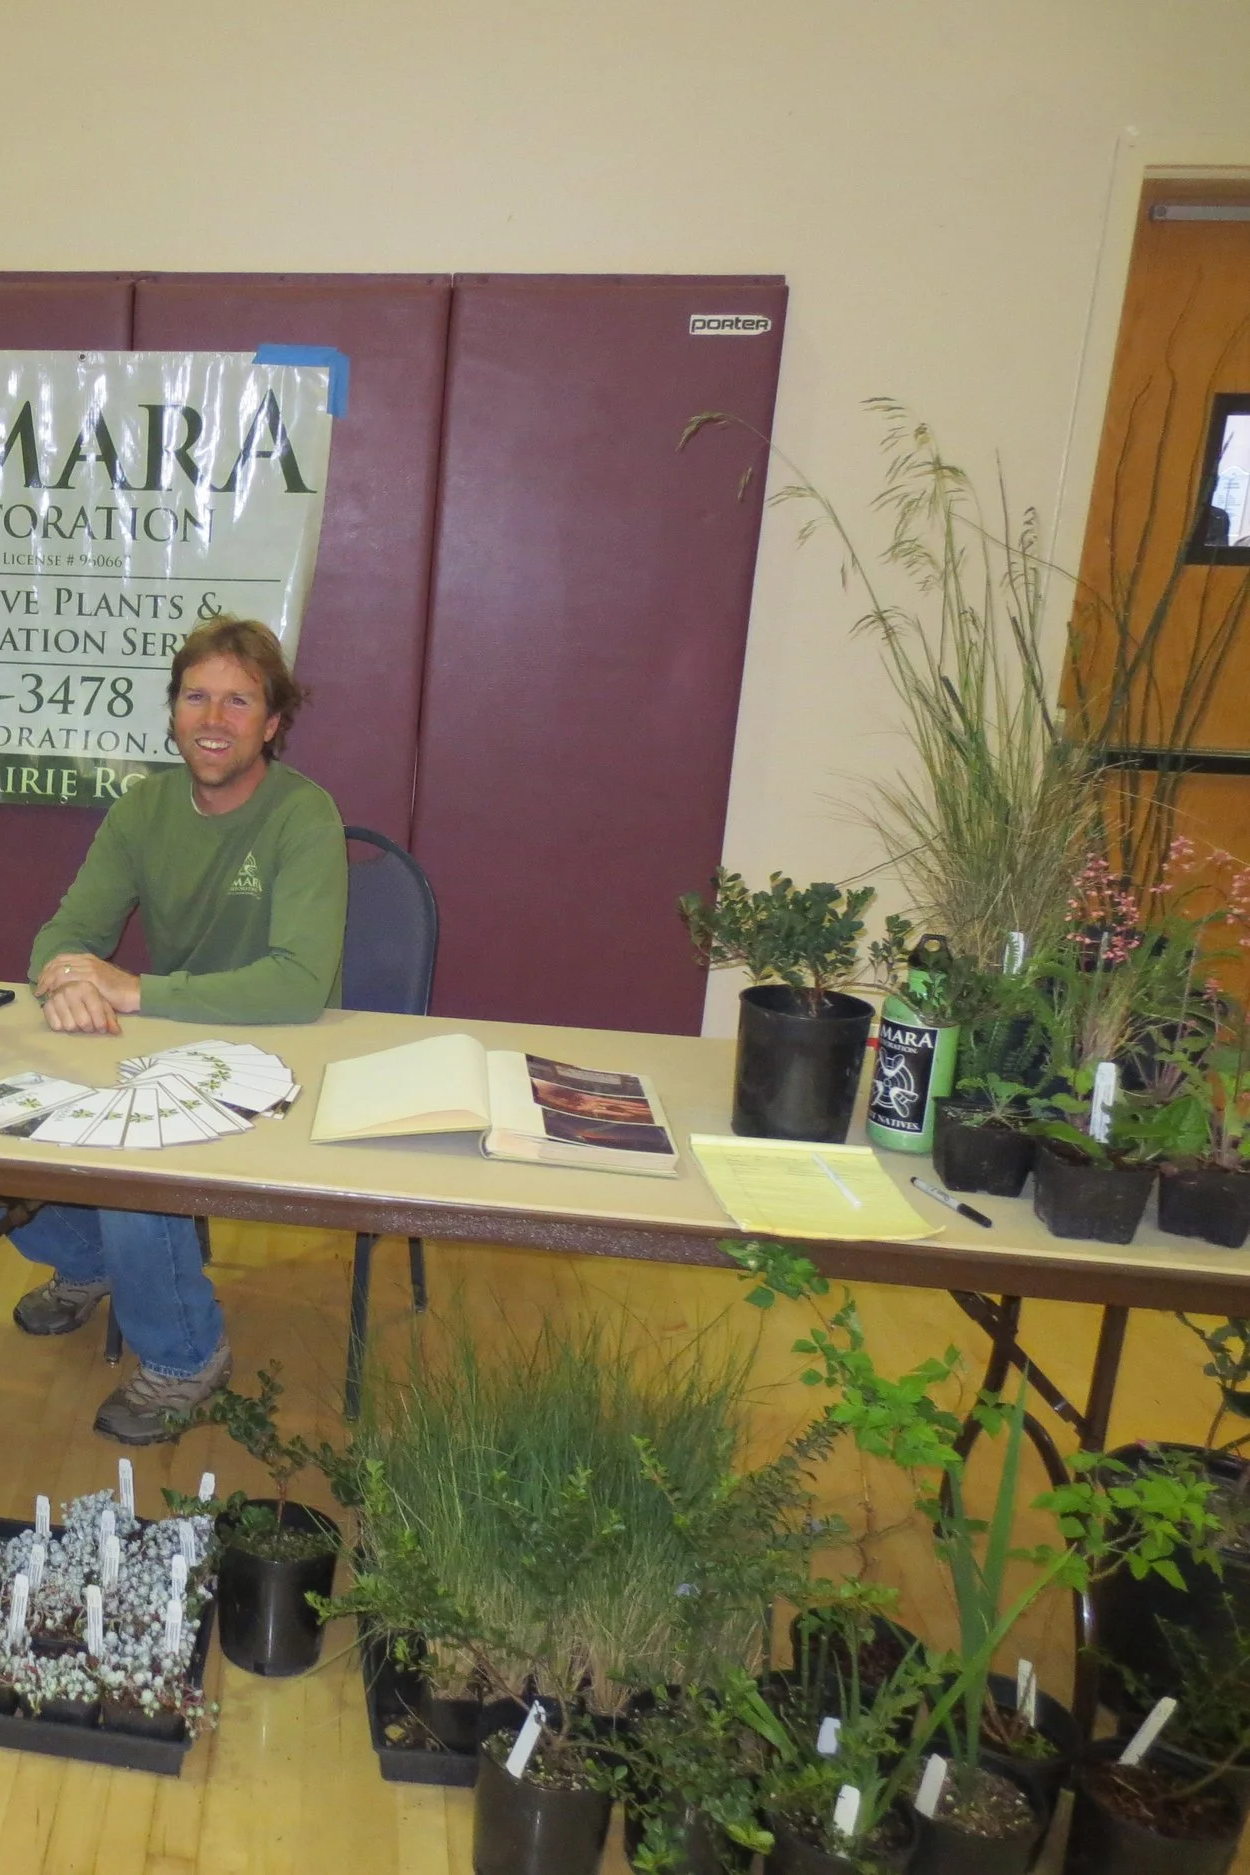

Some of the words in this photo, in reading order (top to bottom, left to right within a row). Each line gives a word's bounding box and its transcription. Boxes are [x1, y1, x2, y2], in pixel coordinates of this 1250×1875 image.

[3, 552, 61, 567] LICENSE
[66, 555, 74, 567] #
[54, 587, 184, 620] PLANTS
[196, 591, 222, 620] &
